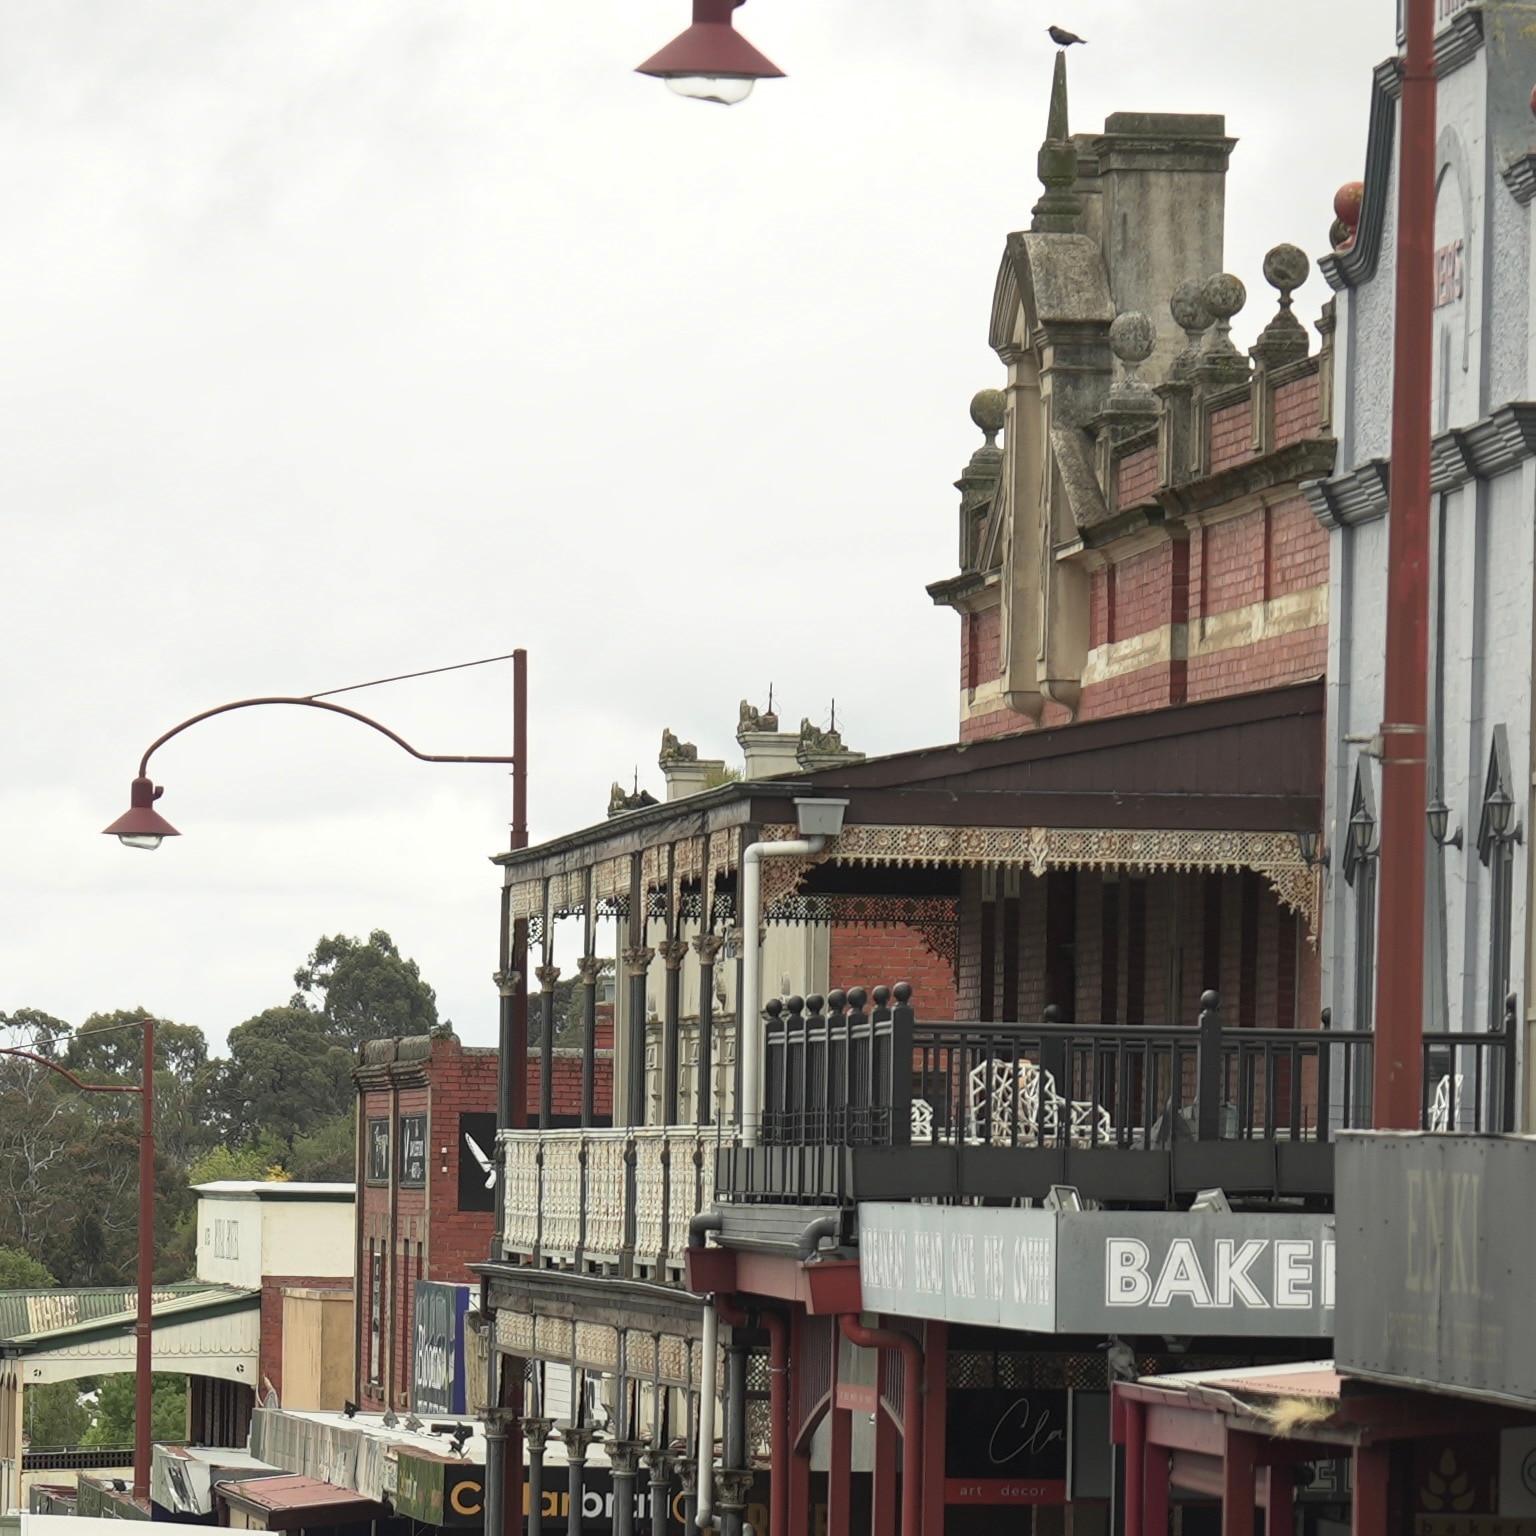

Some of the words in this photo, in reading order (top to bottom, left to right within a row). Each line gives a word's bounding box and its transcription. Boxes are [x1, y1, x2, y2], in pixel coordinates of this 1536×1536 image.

[914, 1231, 944, 1295] BREAD
[951, 1232, 976, 1299] CAKE
[983, 1234, 1005, 1301] PIES
[1013, 1236, 1051, 1305] COFFEE
[959, 1485, 983, 1497] art
[1000, 1483, 1046, 1497] decor
